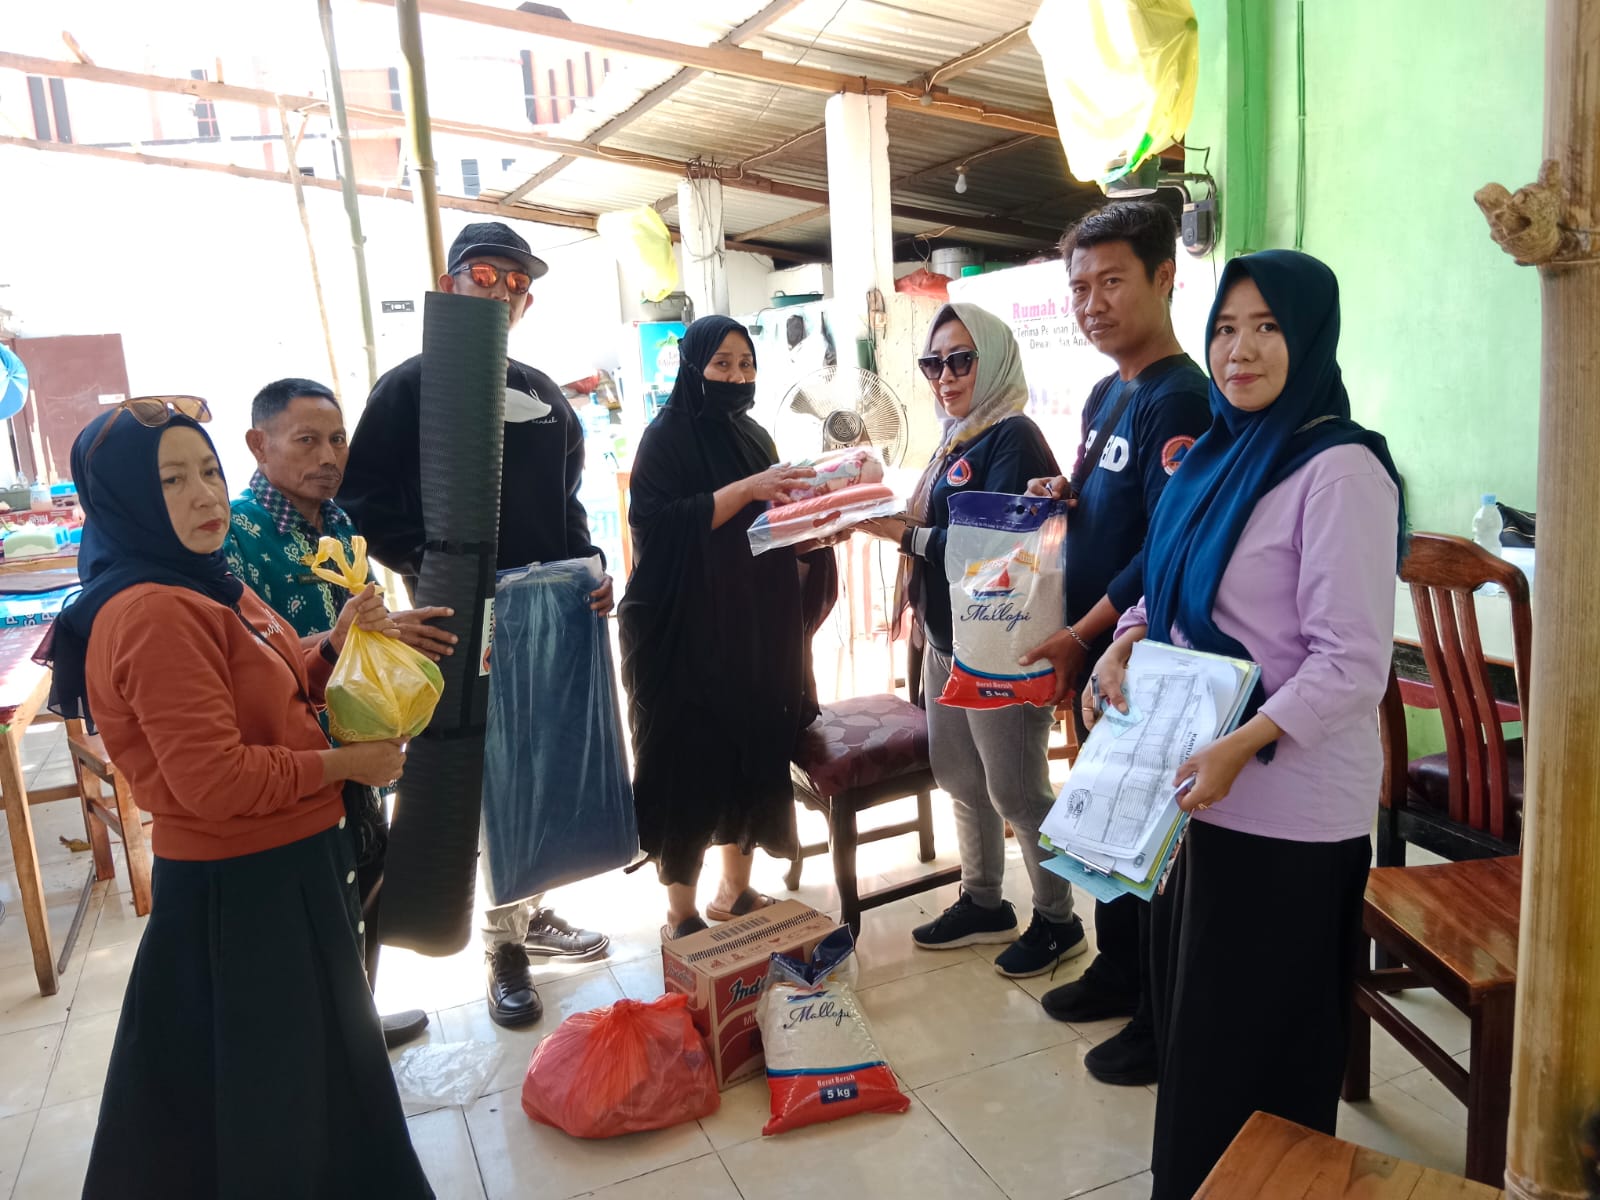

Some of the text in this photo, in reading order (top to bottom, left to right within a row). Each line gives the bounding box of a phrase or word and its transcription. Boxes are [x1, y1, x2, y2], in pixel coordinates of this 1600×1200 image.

[1012, 298, 1056, 319] Rumah
[827, 1087, 851, 1099] 5 kg
